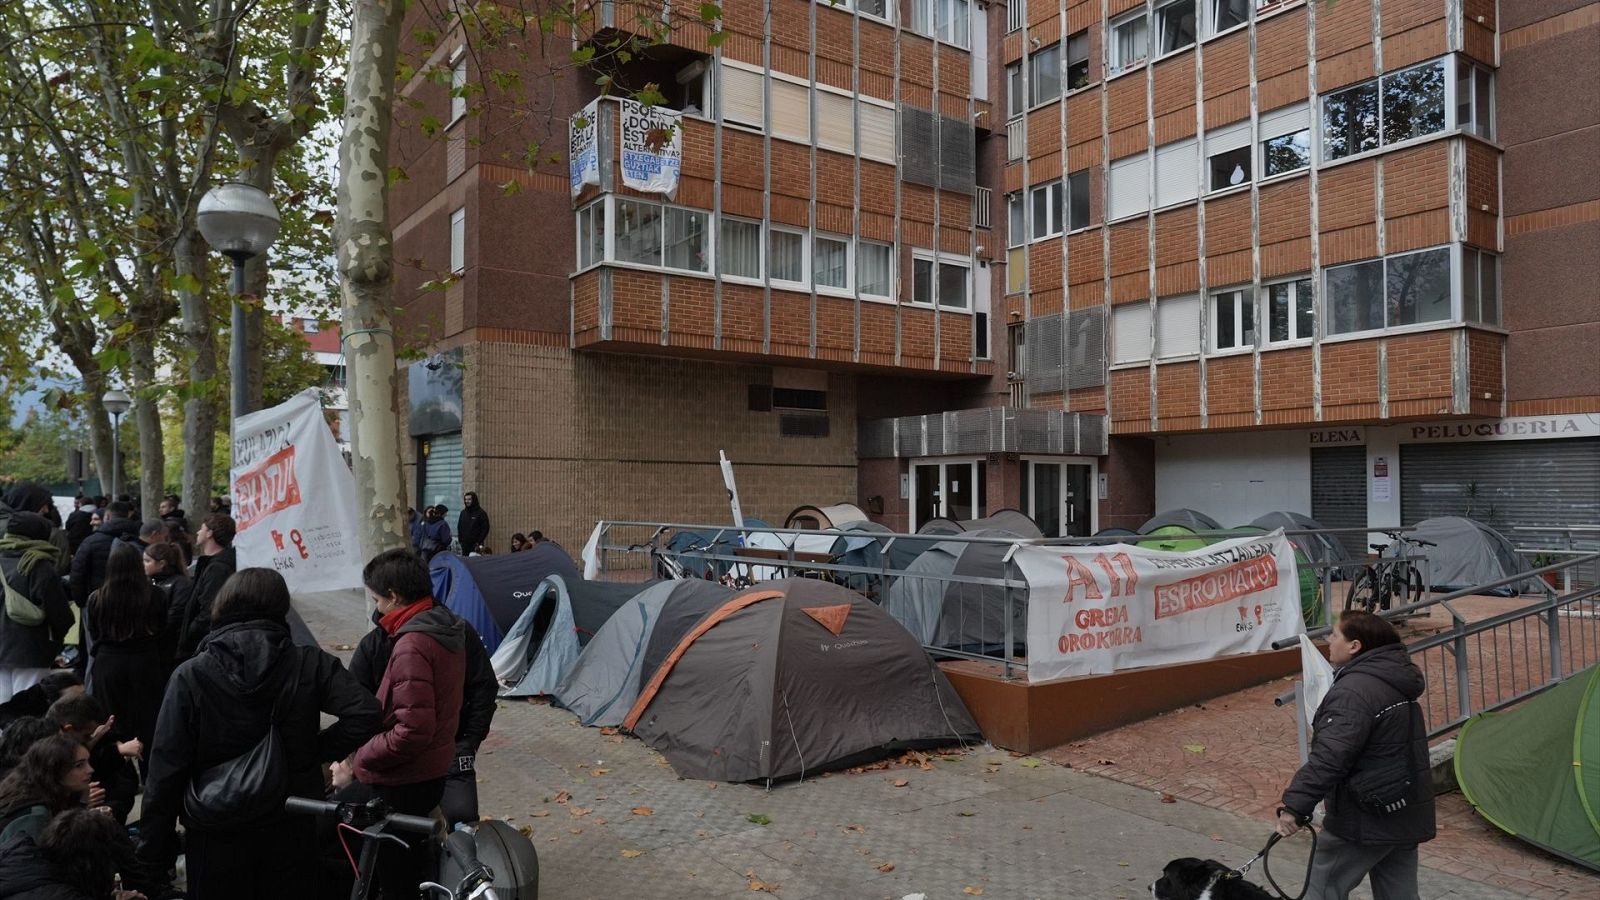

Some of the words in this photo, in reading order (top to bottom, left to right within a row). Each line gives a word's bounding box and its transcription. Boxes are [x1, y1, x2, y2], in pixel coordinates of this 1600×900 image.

[1309, 429, 1361, 444] ELENA
[1411, 419, 1581, 440] PELUQUERIA
[1157, 562, 1273, 613] ESPROPIATU!
